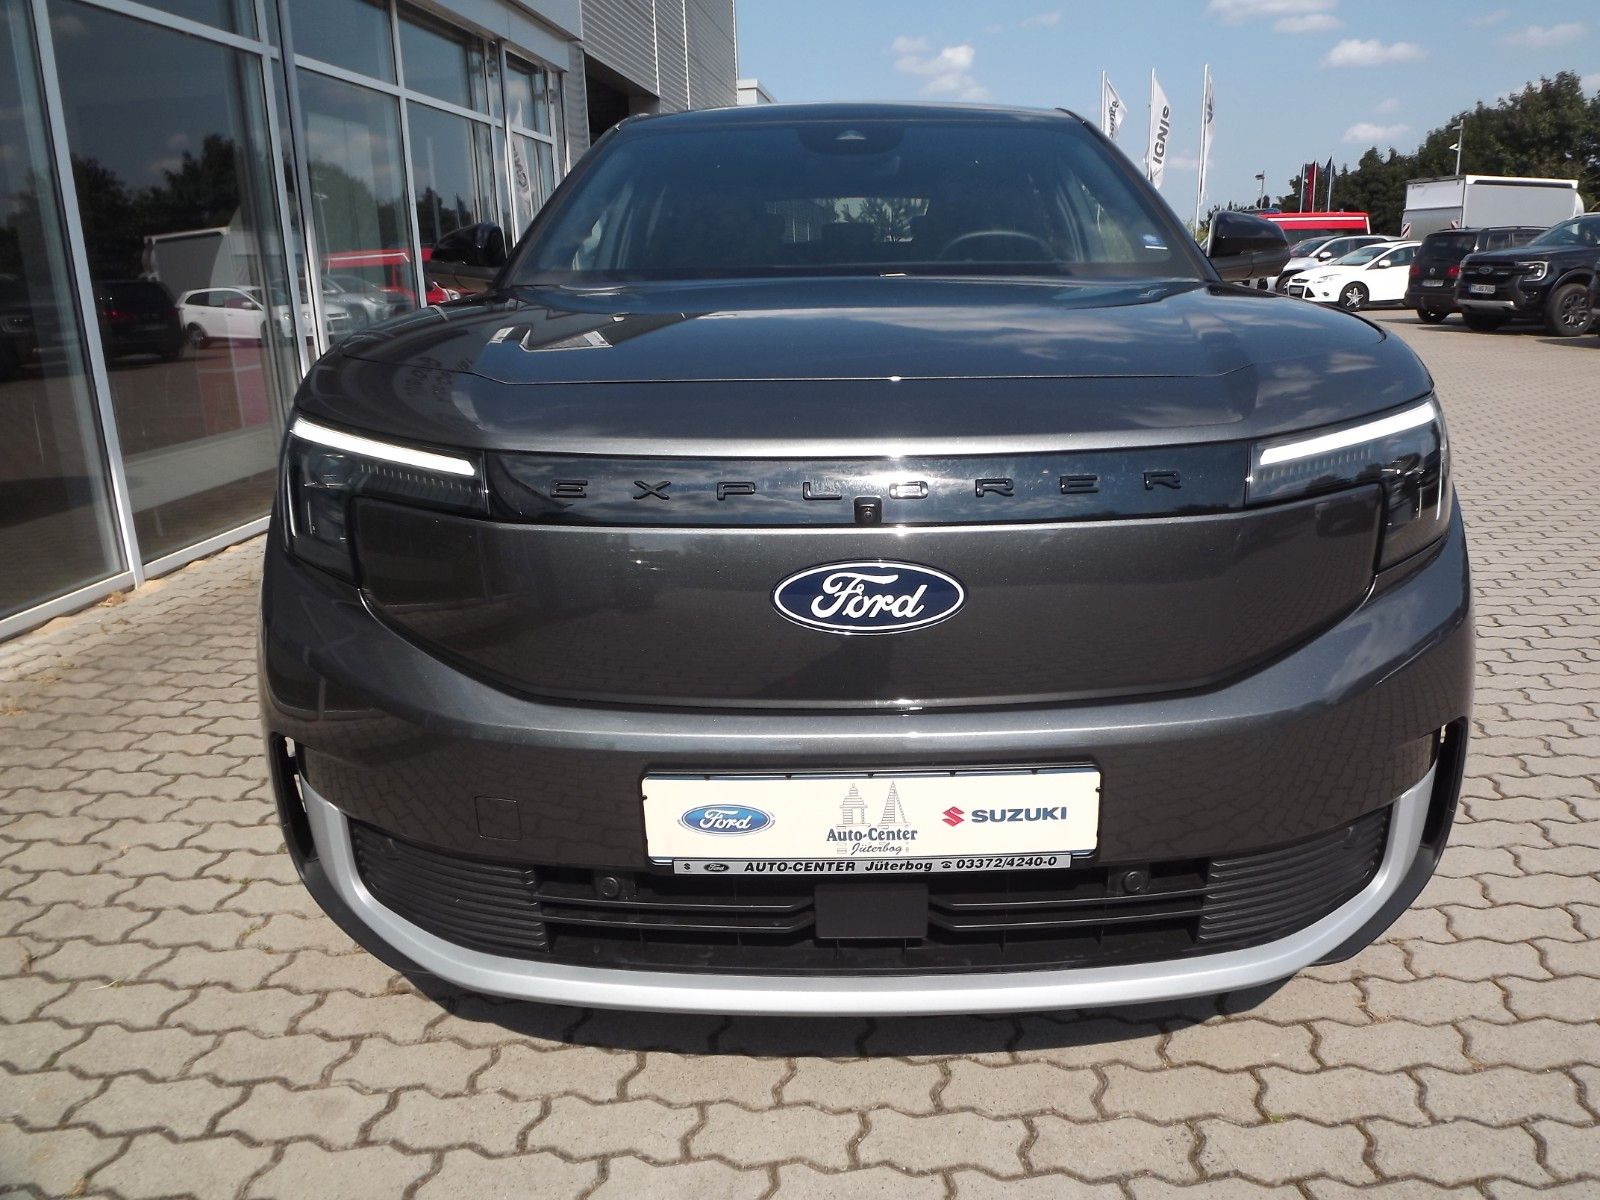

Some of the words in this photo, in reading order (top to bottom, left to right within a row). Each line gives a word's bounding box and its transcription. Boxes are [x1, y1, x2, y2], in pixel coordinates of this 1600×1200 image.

[549, 469, 1182, 501] EXPLORER
[810, 572, 929, 619] Ford
[699, 809, 752, 830] Ford
[971, 806, 1068, 823] SUZUKI
[826, 827, 919, 842] Auto-Center
[850, 841, 903, 856] Jüterbog
[743, 861, 857, 873] AUTO-CENTER
[864, 860, 933, 873] Jüterbog
[956, 856, 1058, 870] 03372/4240-0
